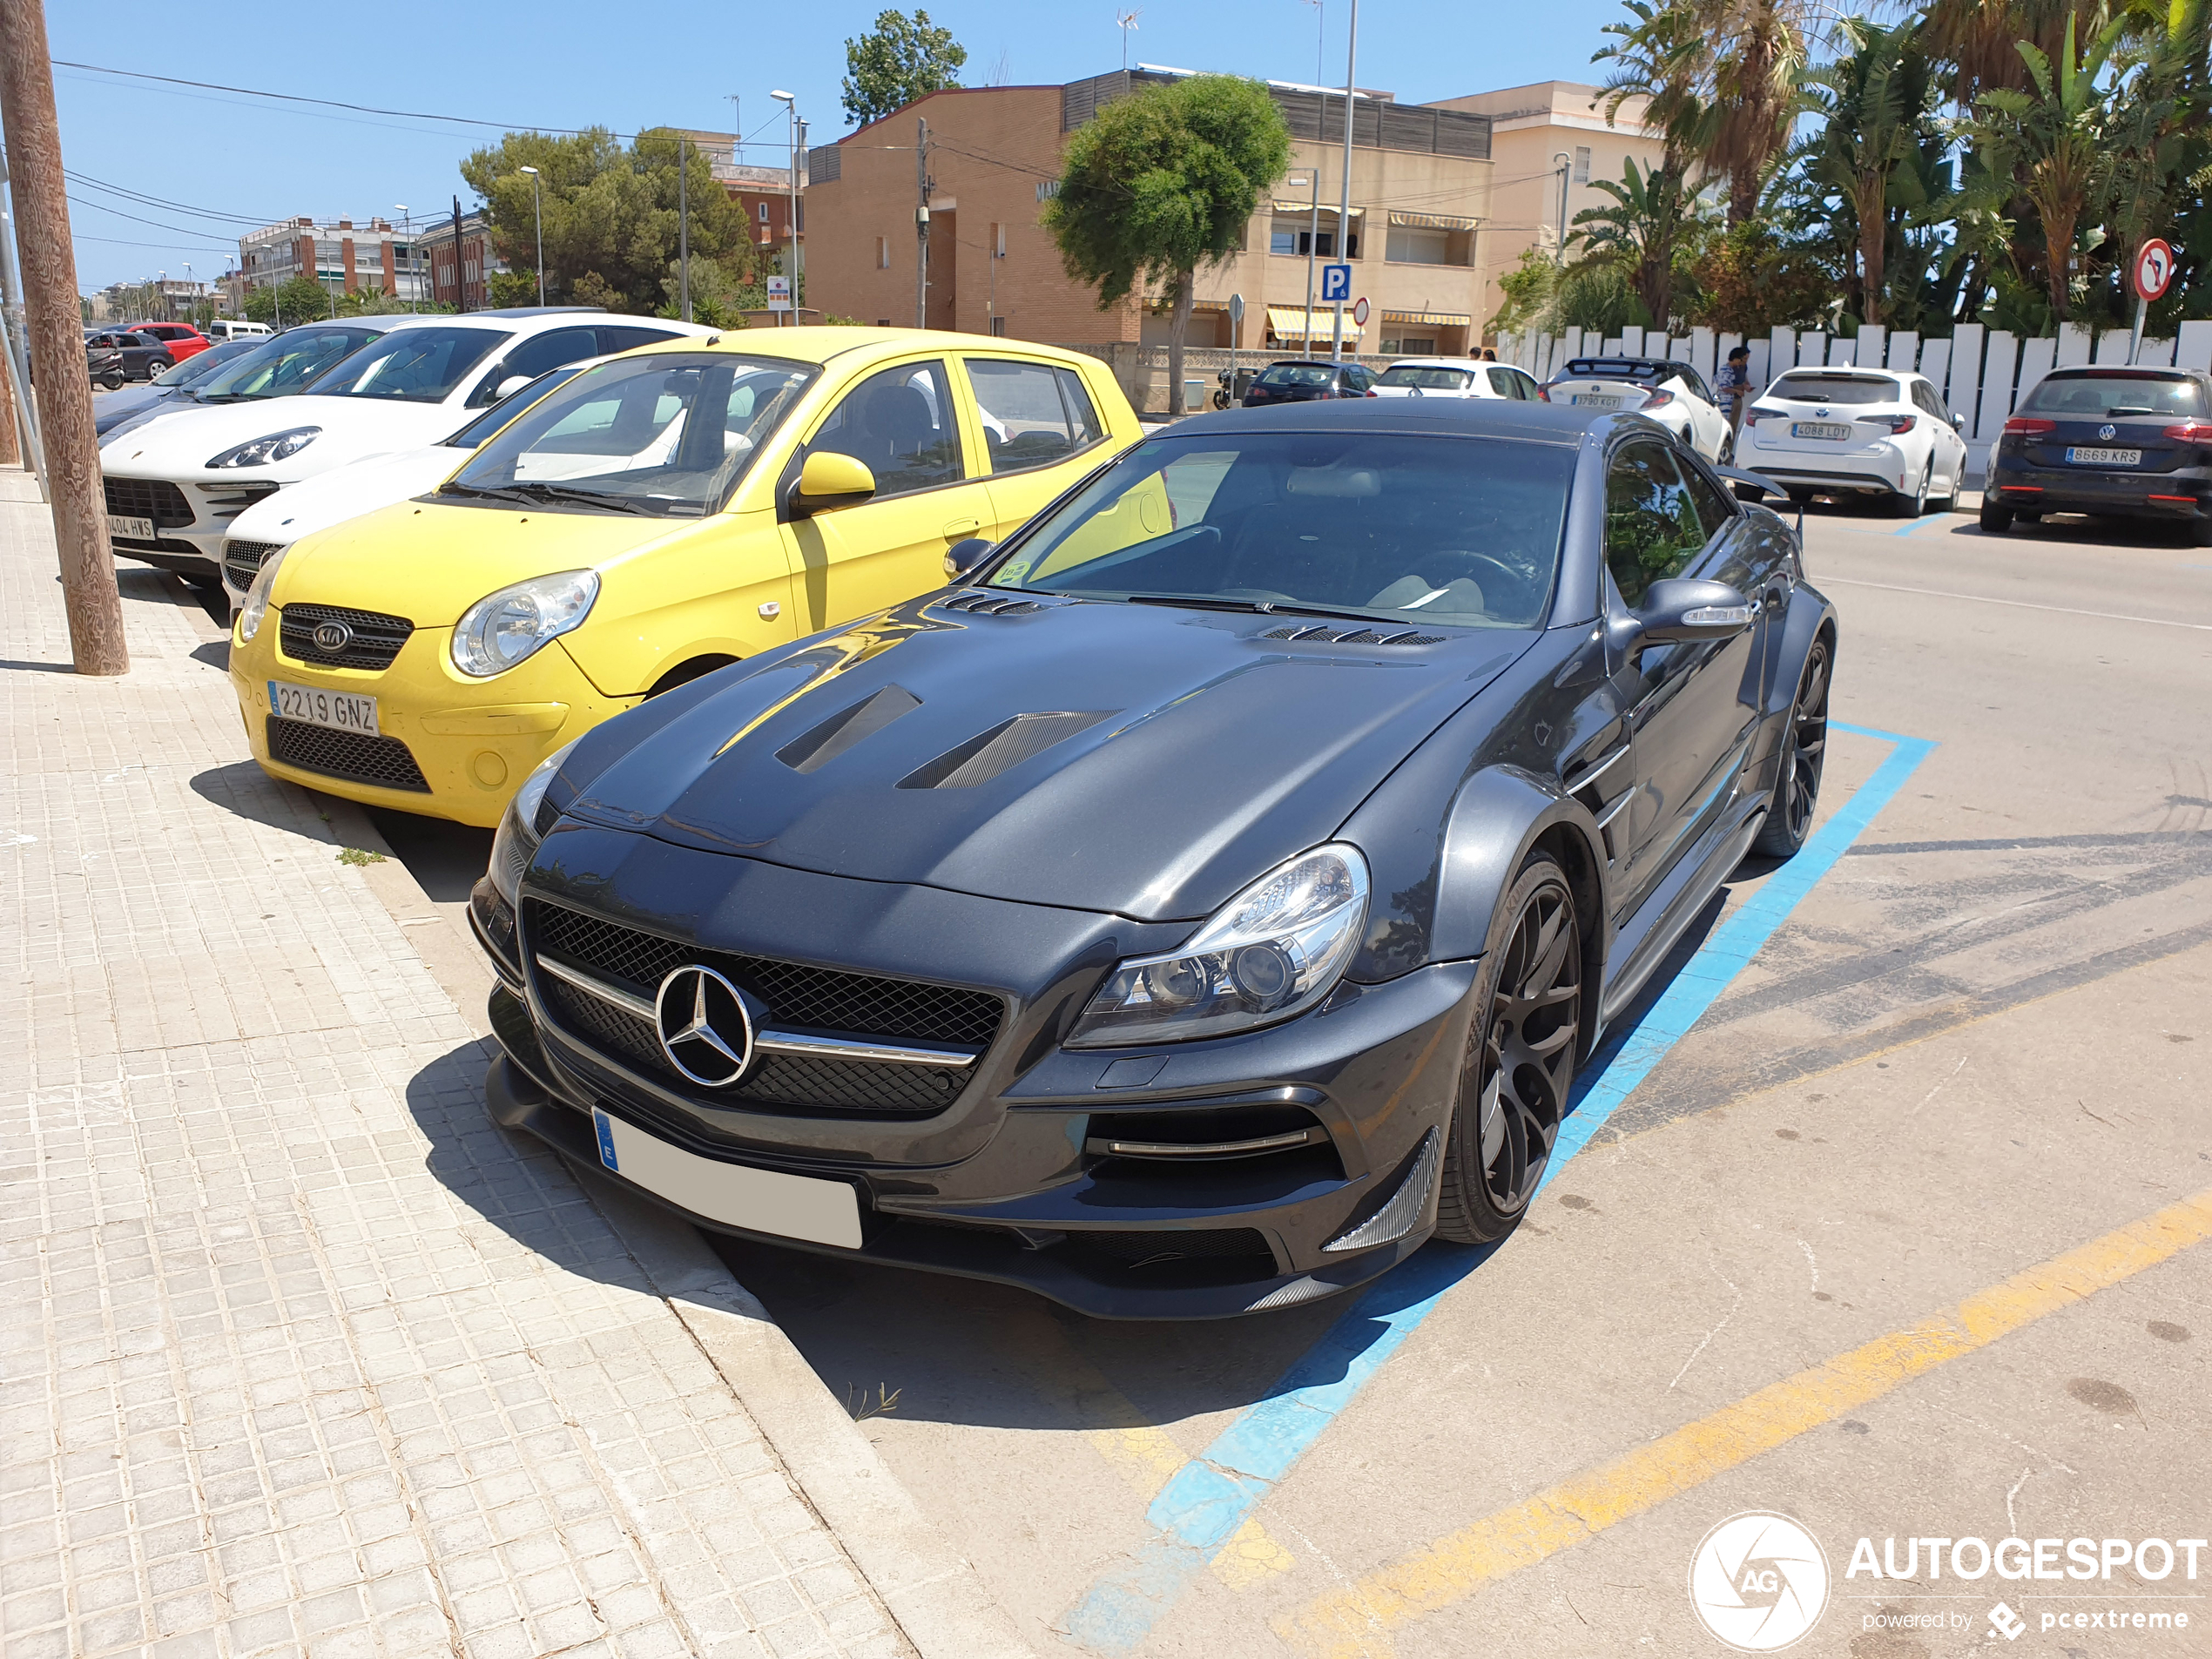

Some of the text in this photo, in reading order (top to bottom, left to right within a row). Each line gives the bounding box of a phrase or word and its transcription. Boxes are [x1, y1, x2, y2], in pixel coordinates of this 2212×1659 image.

[1326, 269, 1345, 298] P
[1577, 396, 1617, 408] 3790 KGY
[1798, 425, 1846, 437] 4088 LDY
[2074, 449, 2136, 462] 8669 KRS
[318, 628, 341, 644] KIA
[280, 687, 329, 723] 2219
[334, 697, 374, 731] GNZ
[604, 1145, 614, 1160] E
